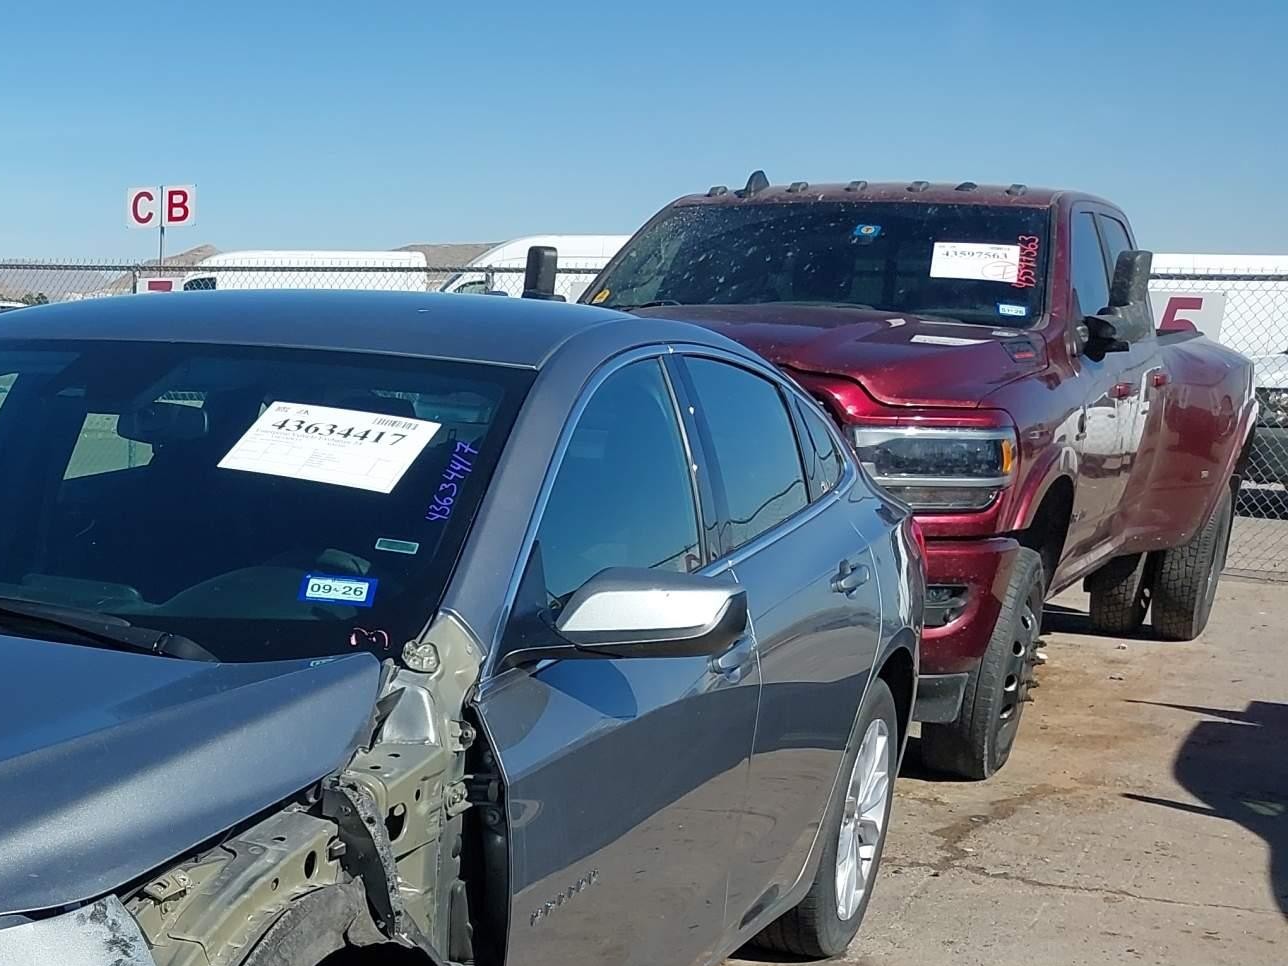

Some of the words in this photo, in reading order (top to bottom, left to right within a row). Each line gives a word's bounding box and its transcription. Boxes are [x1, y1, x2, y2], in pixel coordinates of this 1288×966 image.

[131, 191, 154, 224] C
[167, 189, 190, 223] B
[271, 417, 409, 447] 43634417
[425, 441, 479, 521] 43634417
